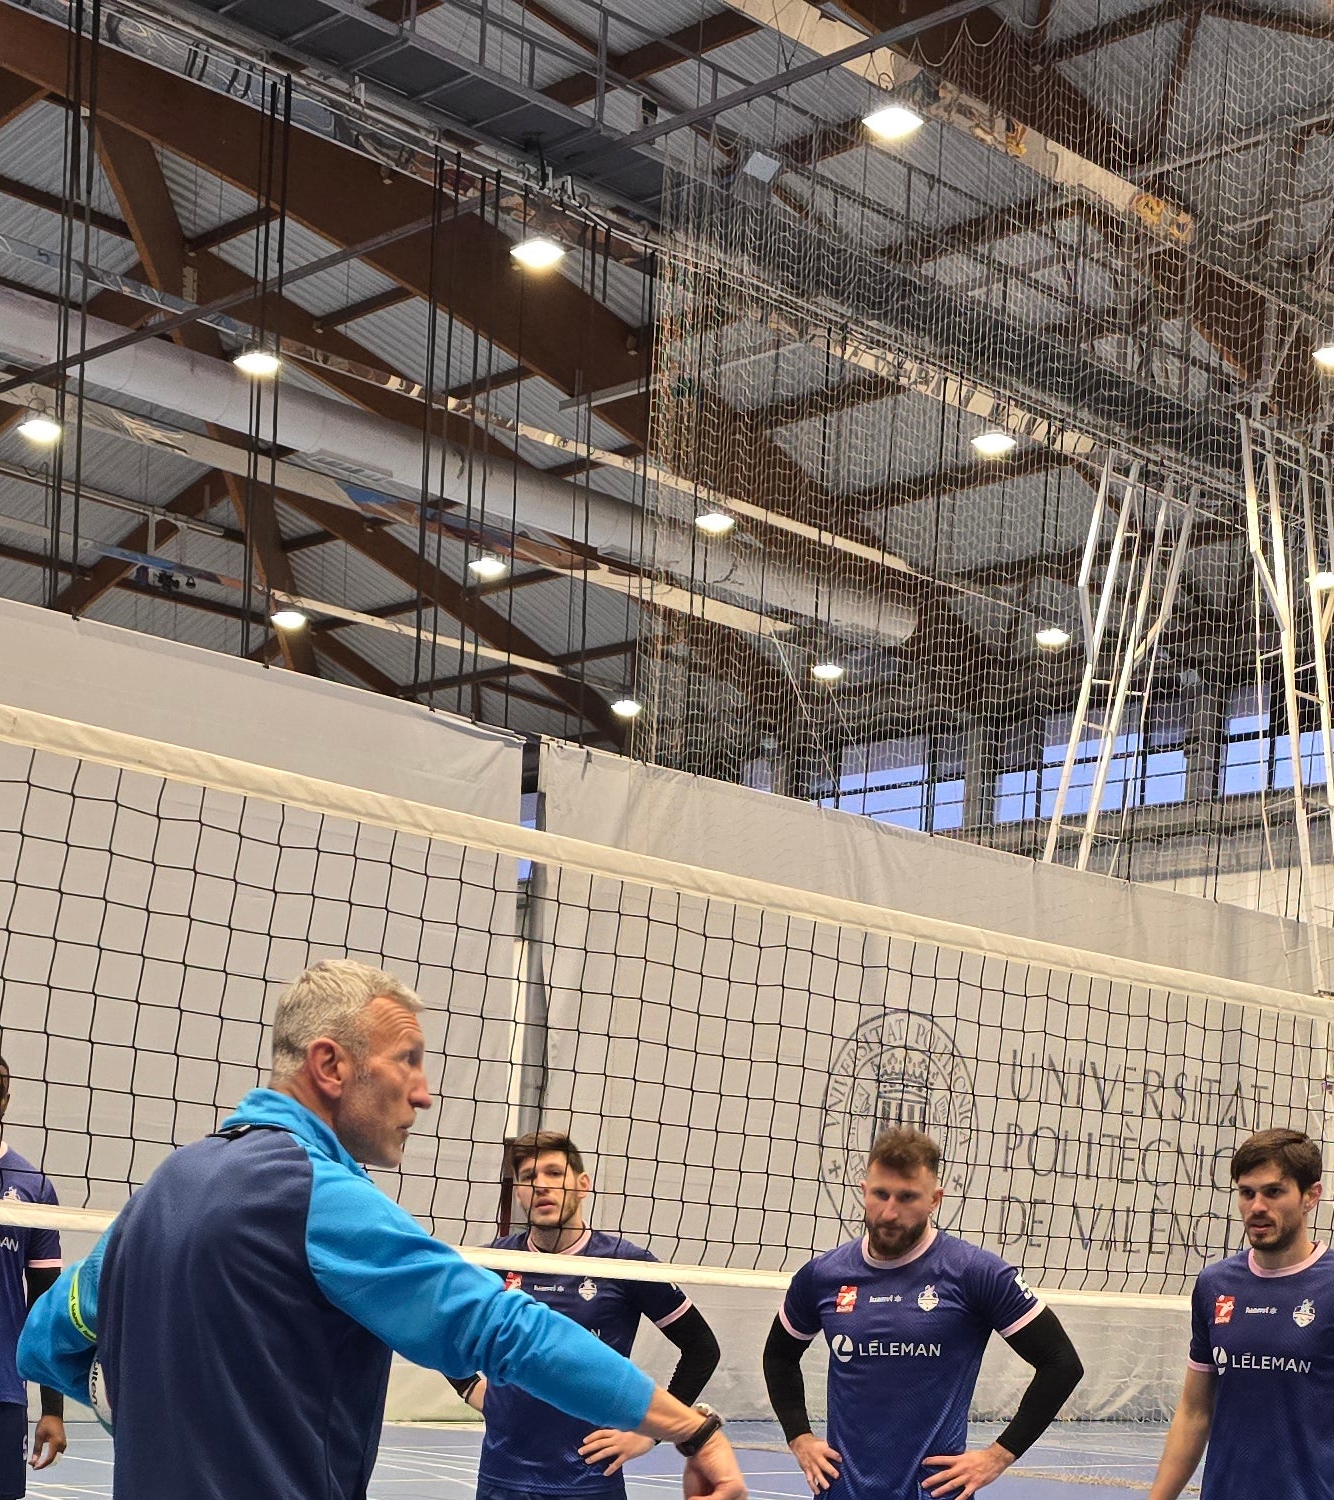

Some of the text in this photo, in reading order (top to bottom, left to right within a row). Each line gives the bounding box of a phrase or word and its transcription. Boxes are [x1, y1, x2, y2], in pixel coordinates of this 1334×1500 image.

[1010, 1048, 1269, 1130] UNIVERSITAT
[1002, 1120, 1237, 1193] POLITÈCNIC
[997, 1193, 1247, 1259] DE VALÈNCI
[858, 1339, 942, 1357] LÉLEMAN
[1231, 1351, 1312, 1375] LÉLEMAN
